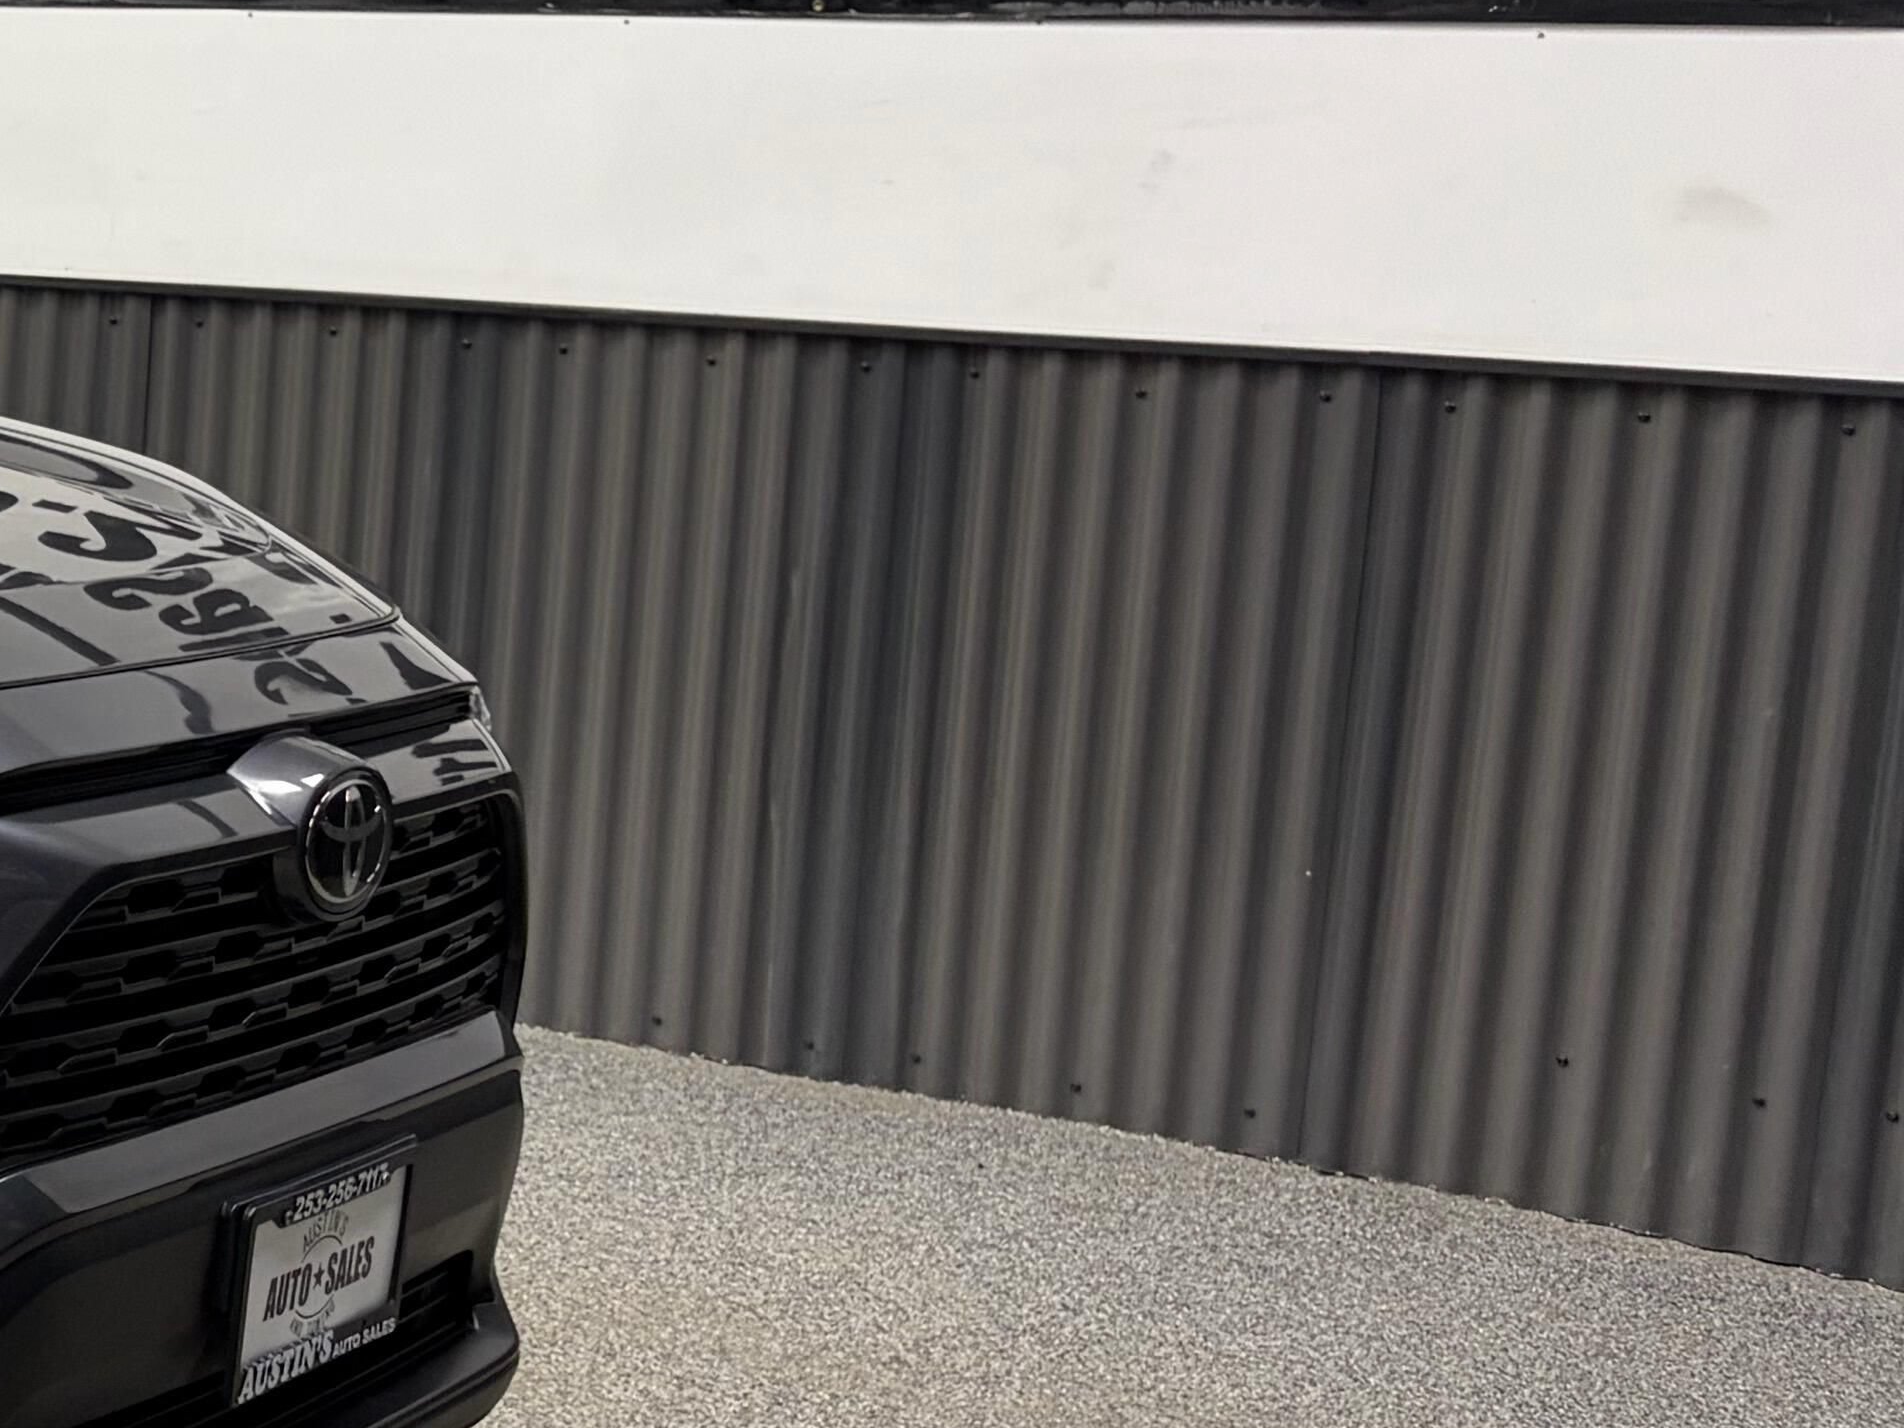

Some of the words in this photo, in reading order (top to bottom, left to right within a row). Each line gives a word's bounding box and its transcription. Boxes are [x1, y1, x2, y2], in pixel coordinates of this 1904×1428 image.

[262, 1262, 313, 1323] AUTO
[323, 1235, 375, 1295] SALES
[237, 1329, 335, 1405] AUSTIN'S
[333, 1334, 361, 1360] AUTO
[361, 1317, 397, 1344] SALES
